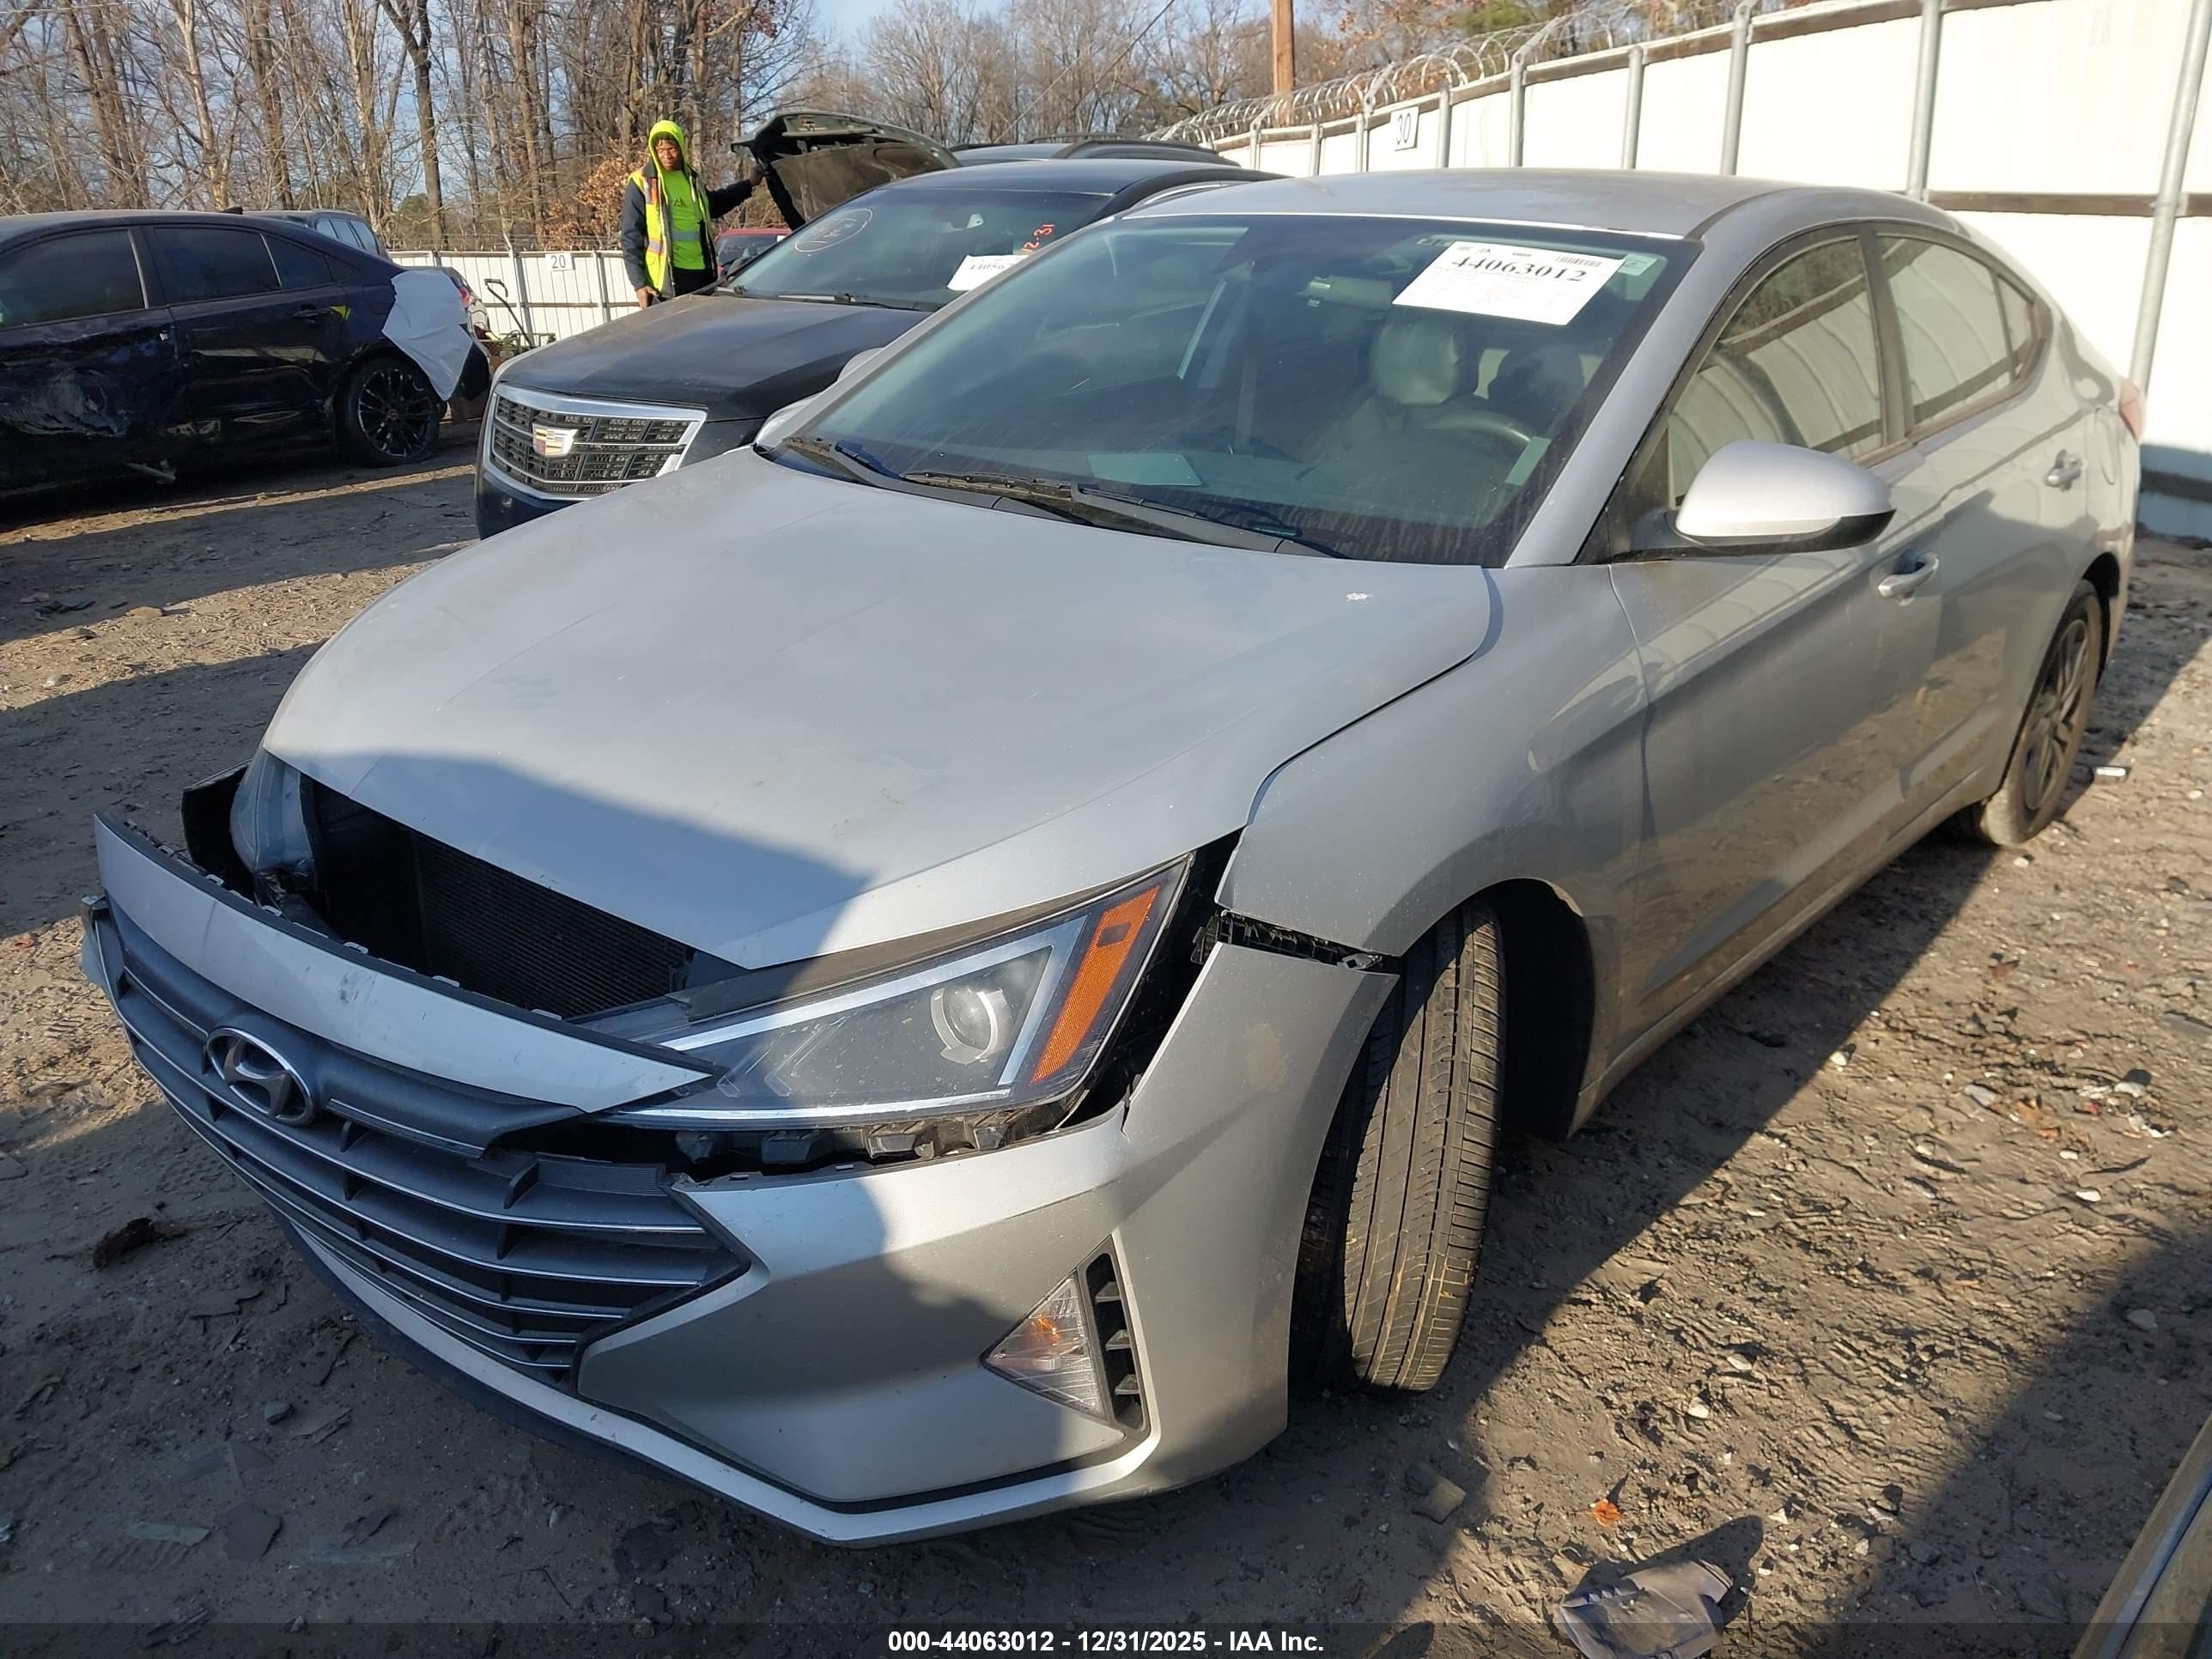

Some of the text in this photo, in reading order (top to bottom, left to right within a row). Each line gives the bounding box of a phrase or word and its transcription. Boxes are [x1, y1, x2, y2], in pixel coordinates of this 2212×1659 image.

[1397, 113, 1411, 144] 30
[550, 254, 566, 268] 20
[1451, 256, 1587, 282] 44063012
